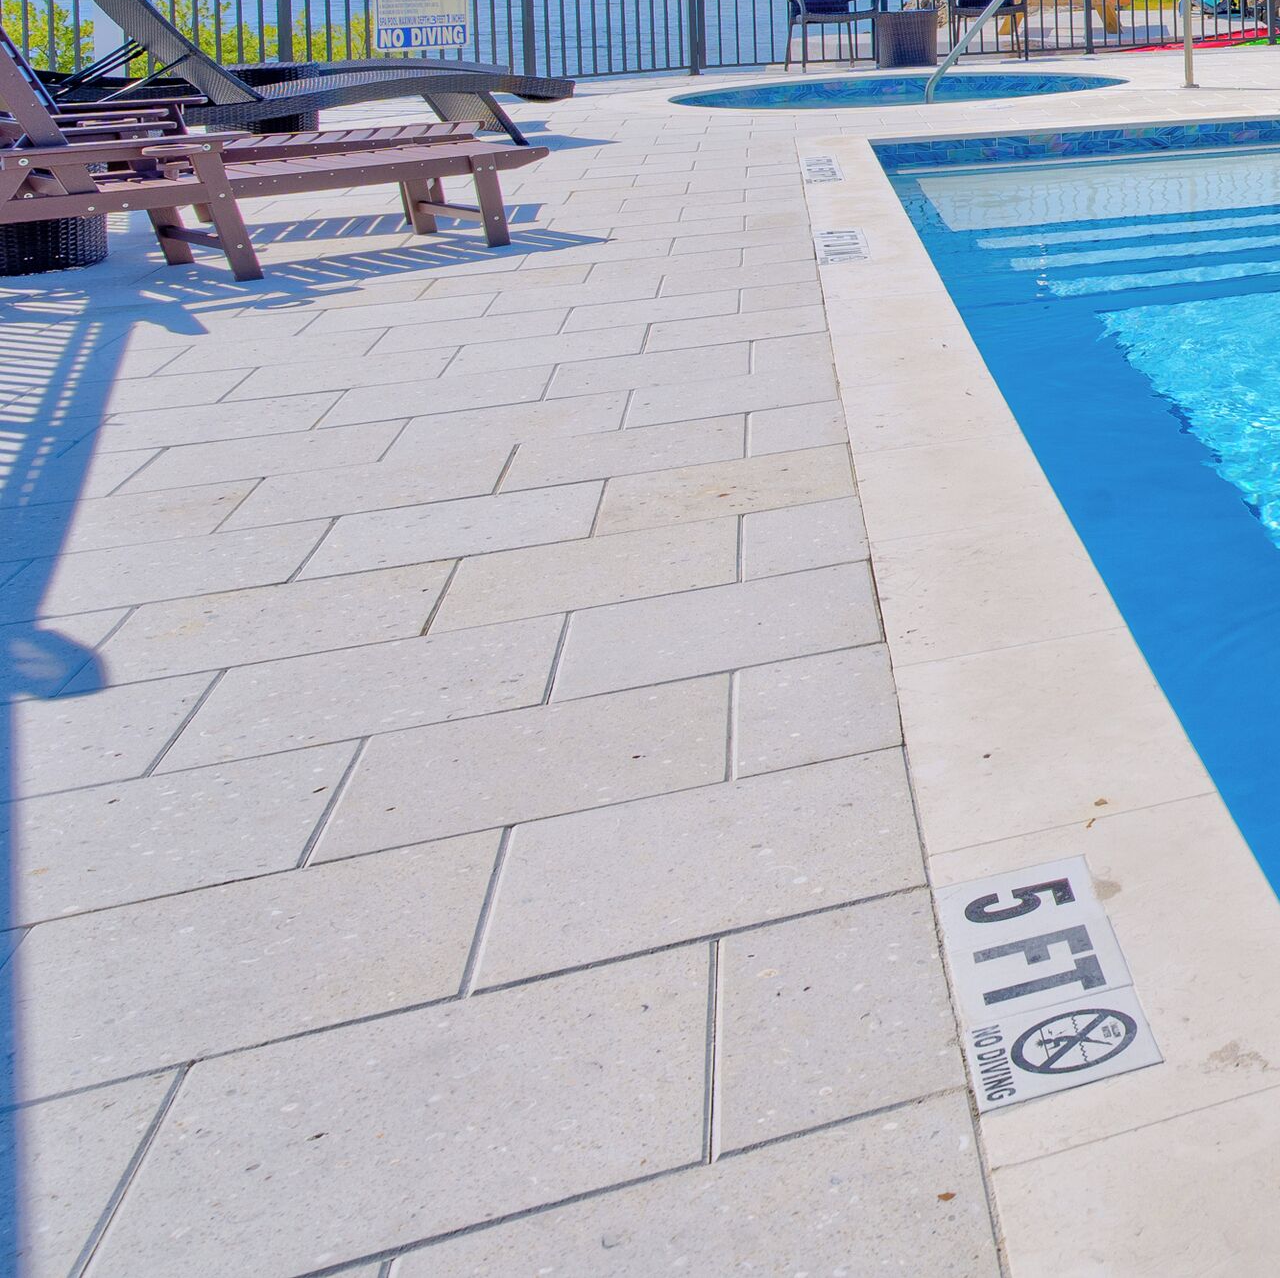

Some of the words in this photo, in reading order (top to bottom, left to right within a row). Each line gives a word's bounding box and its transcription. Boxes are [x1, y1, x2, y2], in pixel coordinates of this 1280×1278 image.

[380, 29, 404, 47] NO
[411, 26, 464, 46] DIVING
[430, 16, 438, 25] 3
[964, 876, 1077, 924] 5
[972, 923, 1107, 1006] FT
[971, 1024, 998, 1048] NO
[976, 1046, 1017, 1102] DIVING
